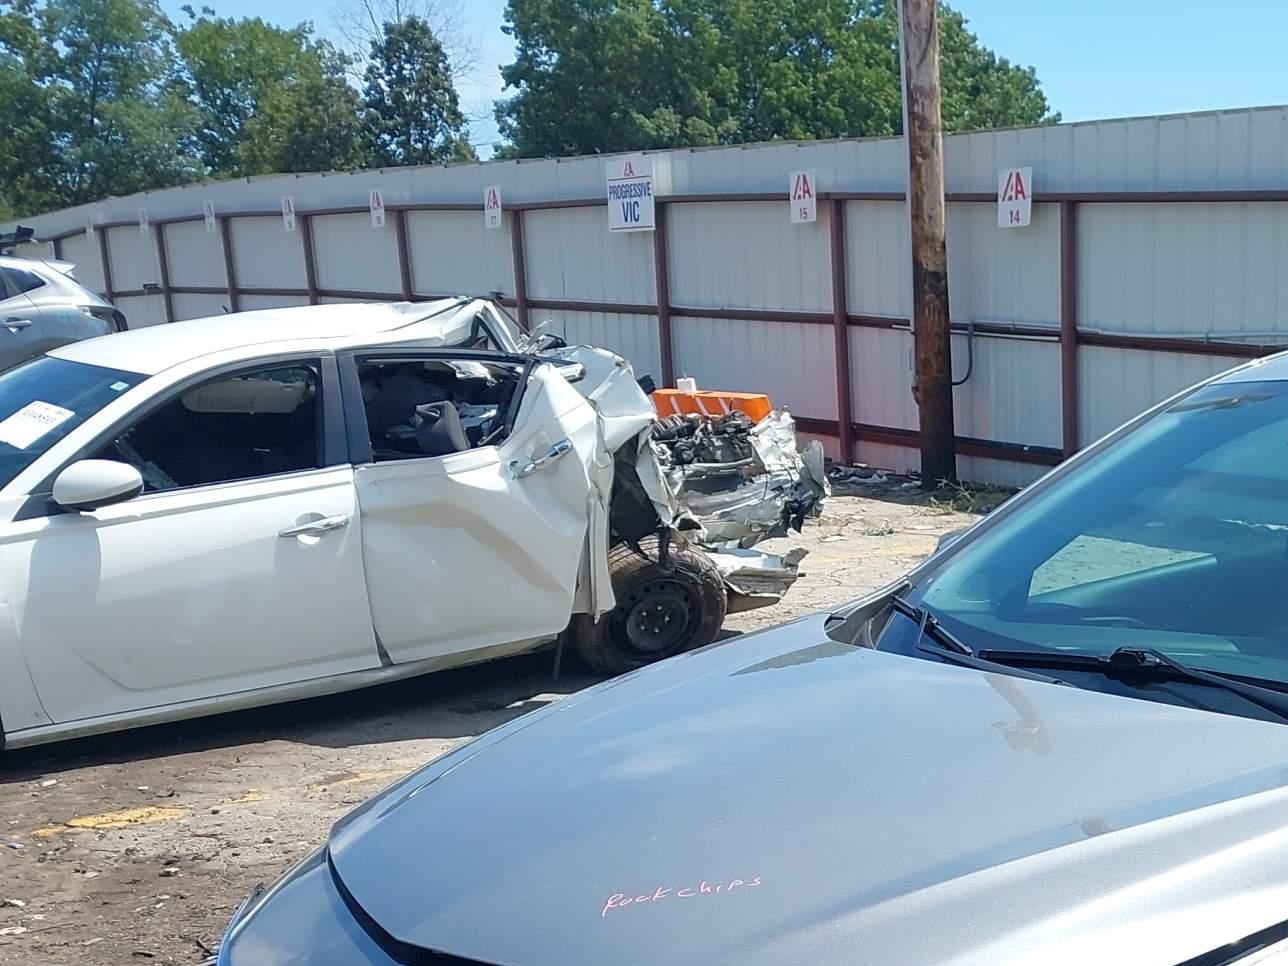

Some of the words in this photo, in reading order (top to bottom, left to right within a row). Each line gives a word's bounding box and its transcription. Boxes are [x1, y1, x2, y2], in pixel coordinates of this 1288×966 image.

[609, 182, 651, 200] PROGRESSIVE
[622, 201, 640, 222] VIC
[799, 208, 808, 220] 15
[1010, 210, 1020, 224] 14
